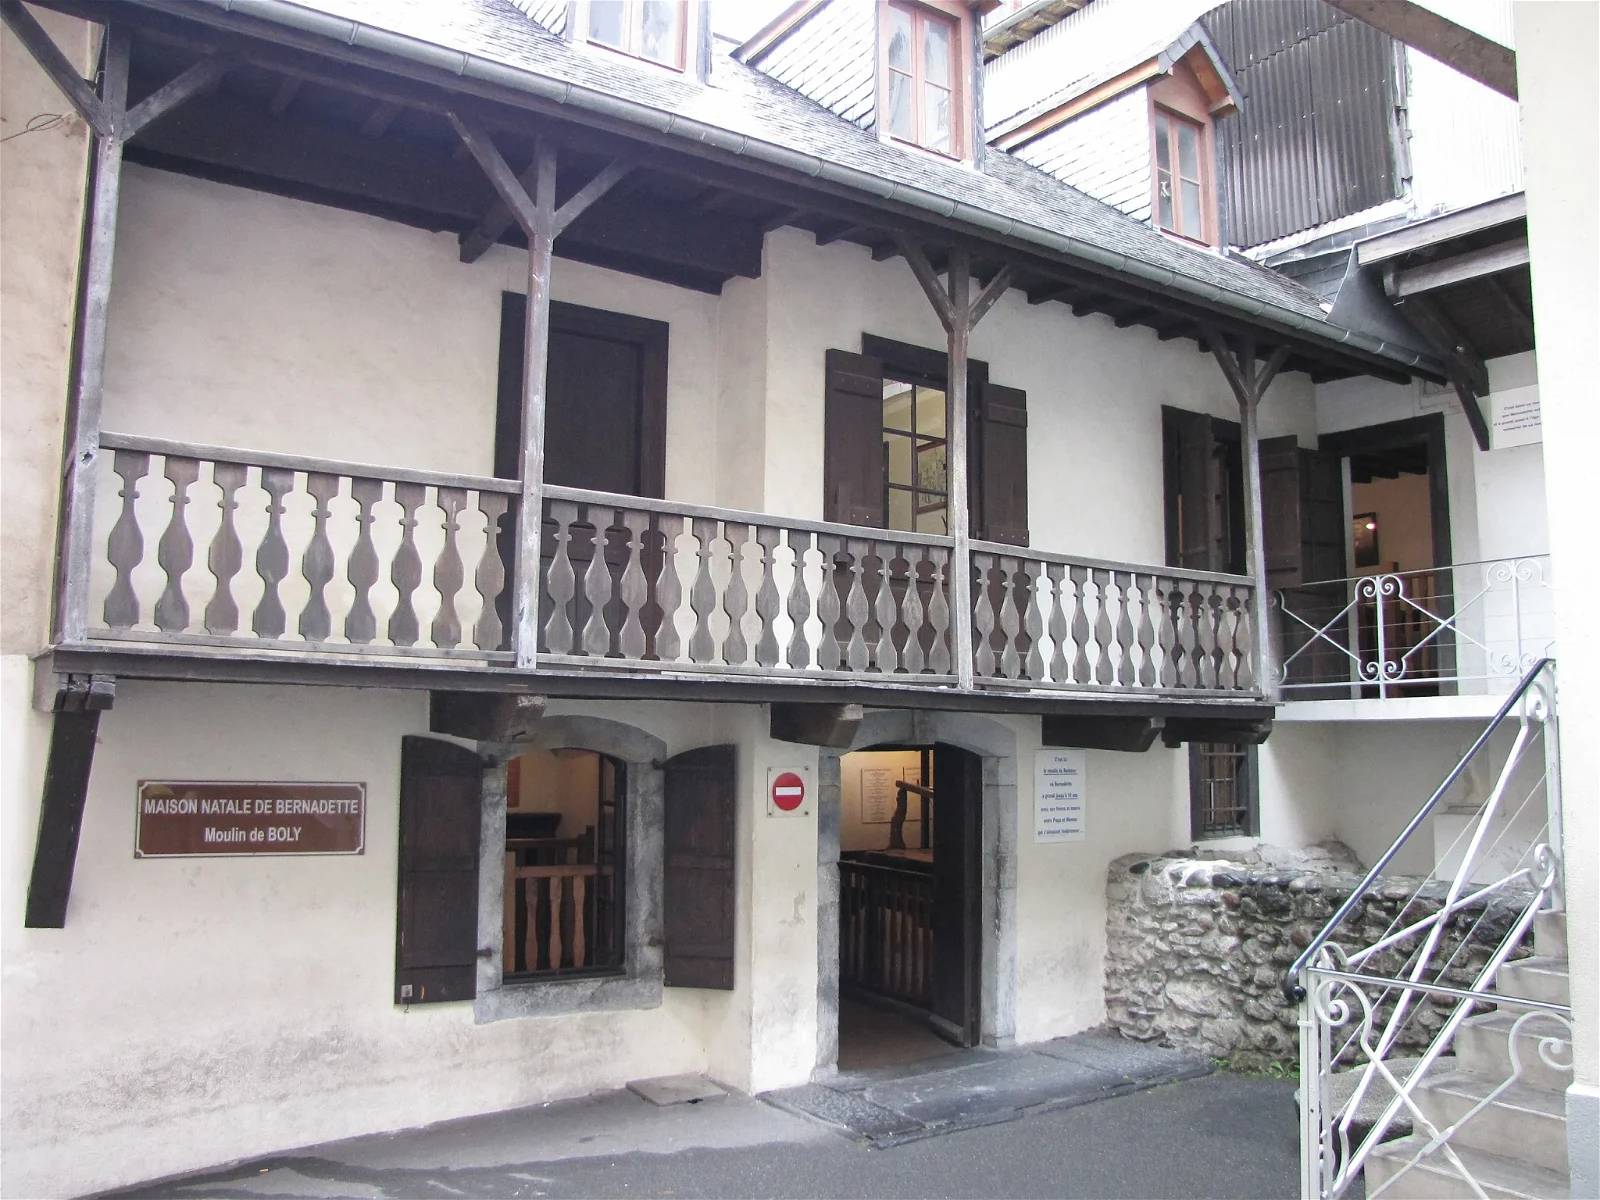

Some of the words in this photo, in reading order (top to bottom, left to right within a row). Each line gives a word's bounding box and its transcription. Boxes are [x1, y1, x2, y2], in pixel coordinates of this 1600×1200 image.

[144, 799, 198, 814] MAISON
[201, 799, 251, 814] NATALE
[255, 799, 272, 814] DE
[276, 799, 358, 814] BERNADETTE
[204, 826, 246, 842] Moulin
[250, 827, 264, 842] de
[268, 826, 302, 842] BOLY
